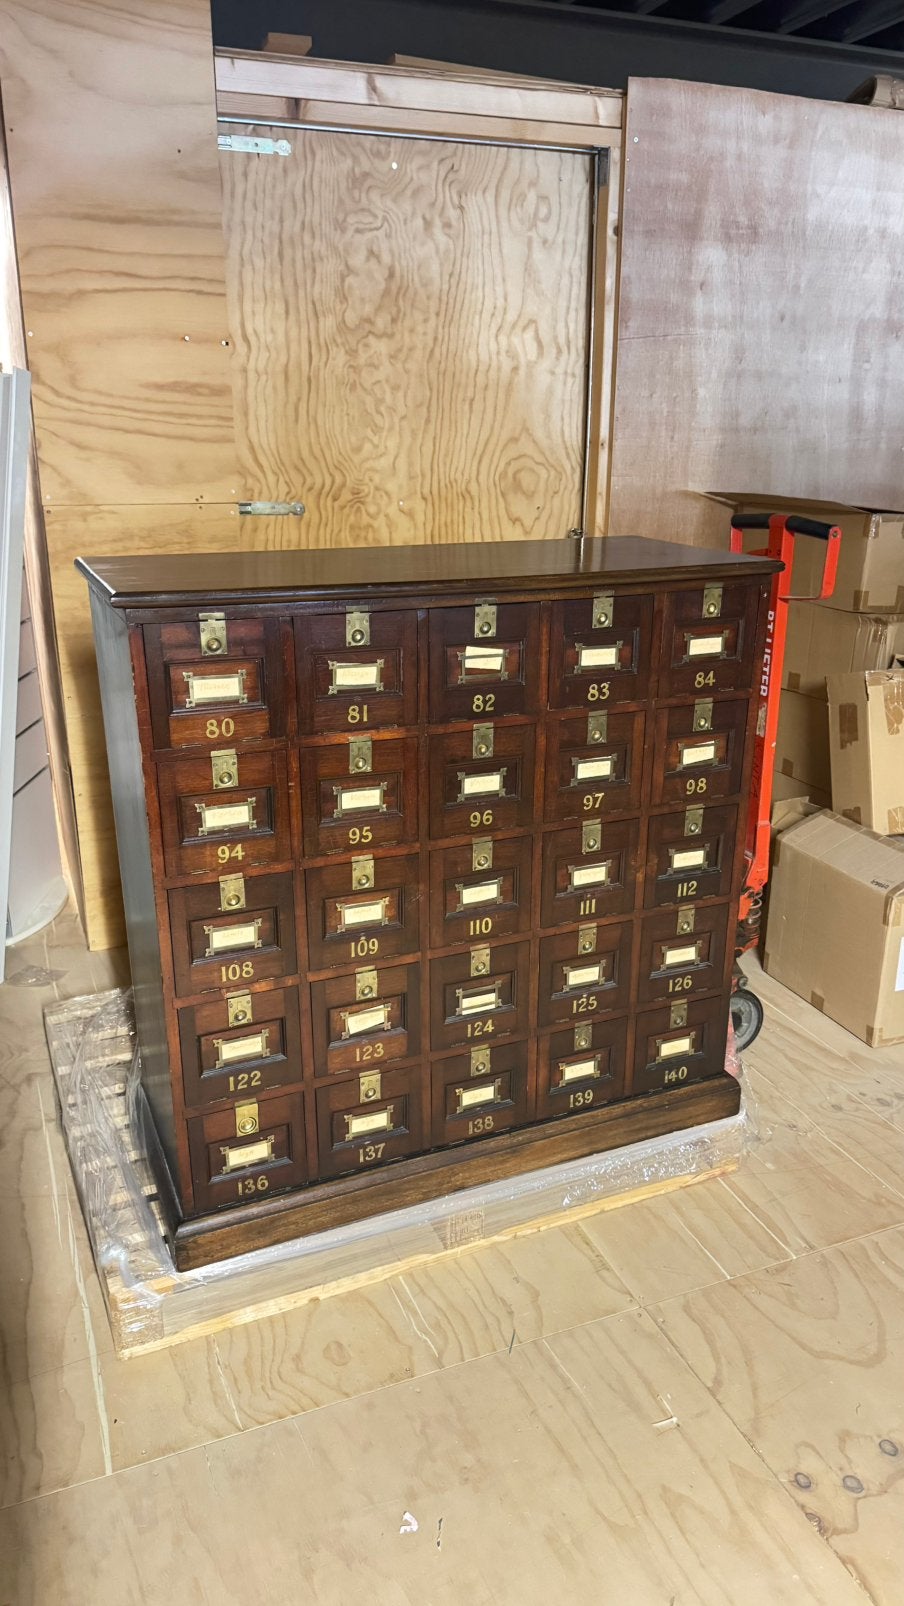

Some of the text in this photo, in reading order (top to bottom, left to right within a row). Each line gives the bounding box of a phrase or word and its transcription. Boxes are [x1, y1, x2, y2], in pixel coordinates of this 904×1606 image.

[694, 670, 716, 688] 84
[587, 682, 610, 702] 83
[472, 693, 496, 713] 82
[347, 704, 369, 725] 81
[205, 717, 235, 739] 80
[685, 777, 707, 795] 98
[583, 792, 605, 811] 97
[469, 809, 493, 828] 96
[348, 826, 373, 845] 95
[217, 844, 245, 864] 94
[677, 881, 697, 897] 112
[579, 899, 597, 915] 111
[469, 917, 493, 936] 110
[350, 938, 379, 958] 109
[220, 961, 255, 982] 108
[668, 975, 693, 993] 126
[572, 998, 598, 1014] 125
[466, 1021, 495, 1038] 124
[355, 1042, 385, 1062] 123
[228, 1070, 262, 1092] 122
[664, 1066, 688, 1084] 140
[569, 1089, 594, 1108] 139
[468, 1115, 494, 1135] 138
[358, 1142, 386, 1163] 137
[237, 1175, 269, 1196] 136
